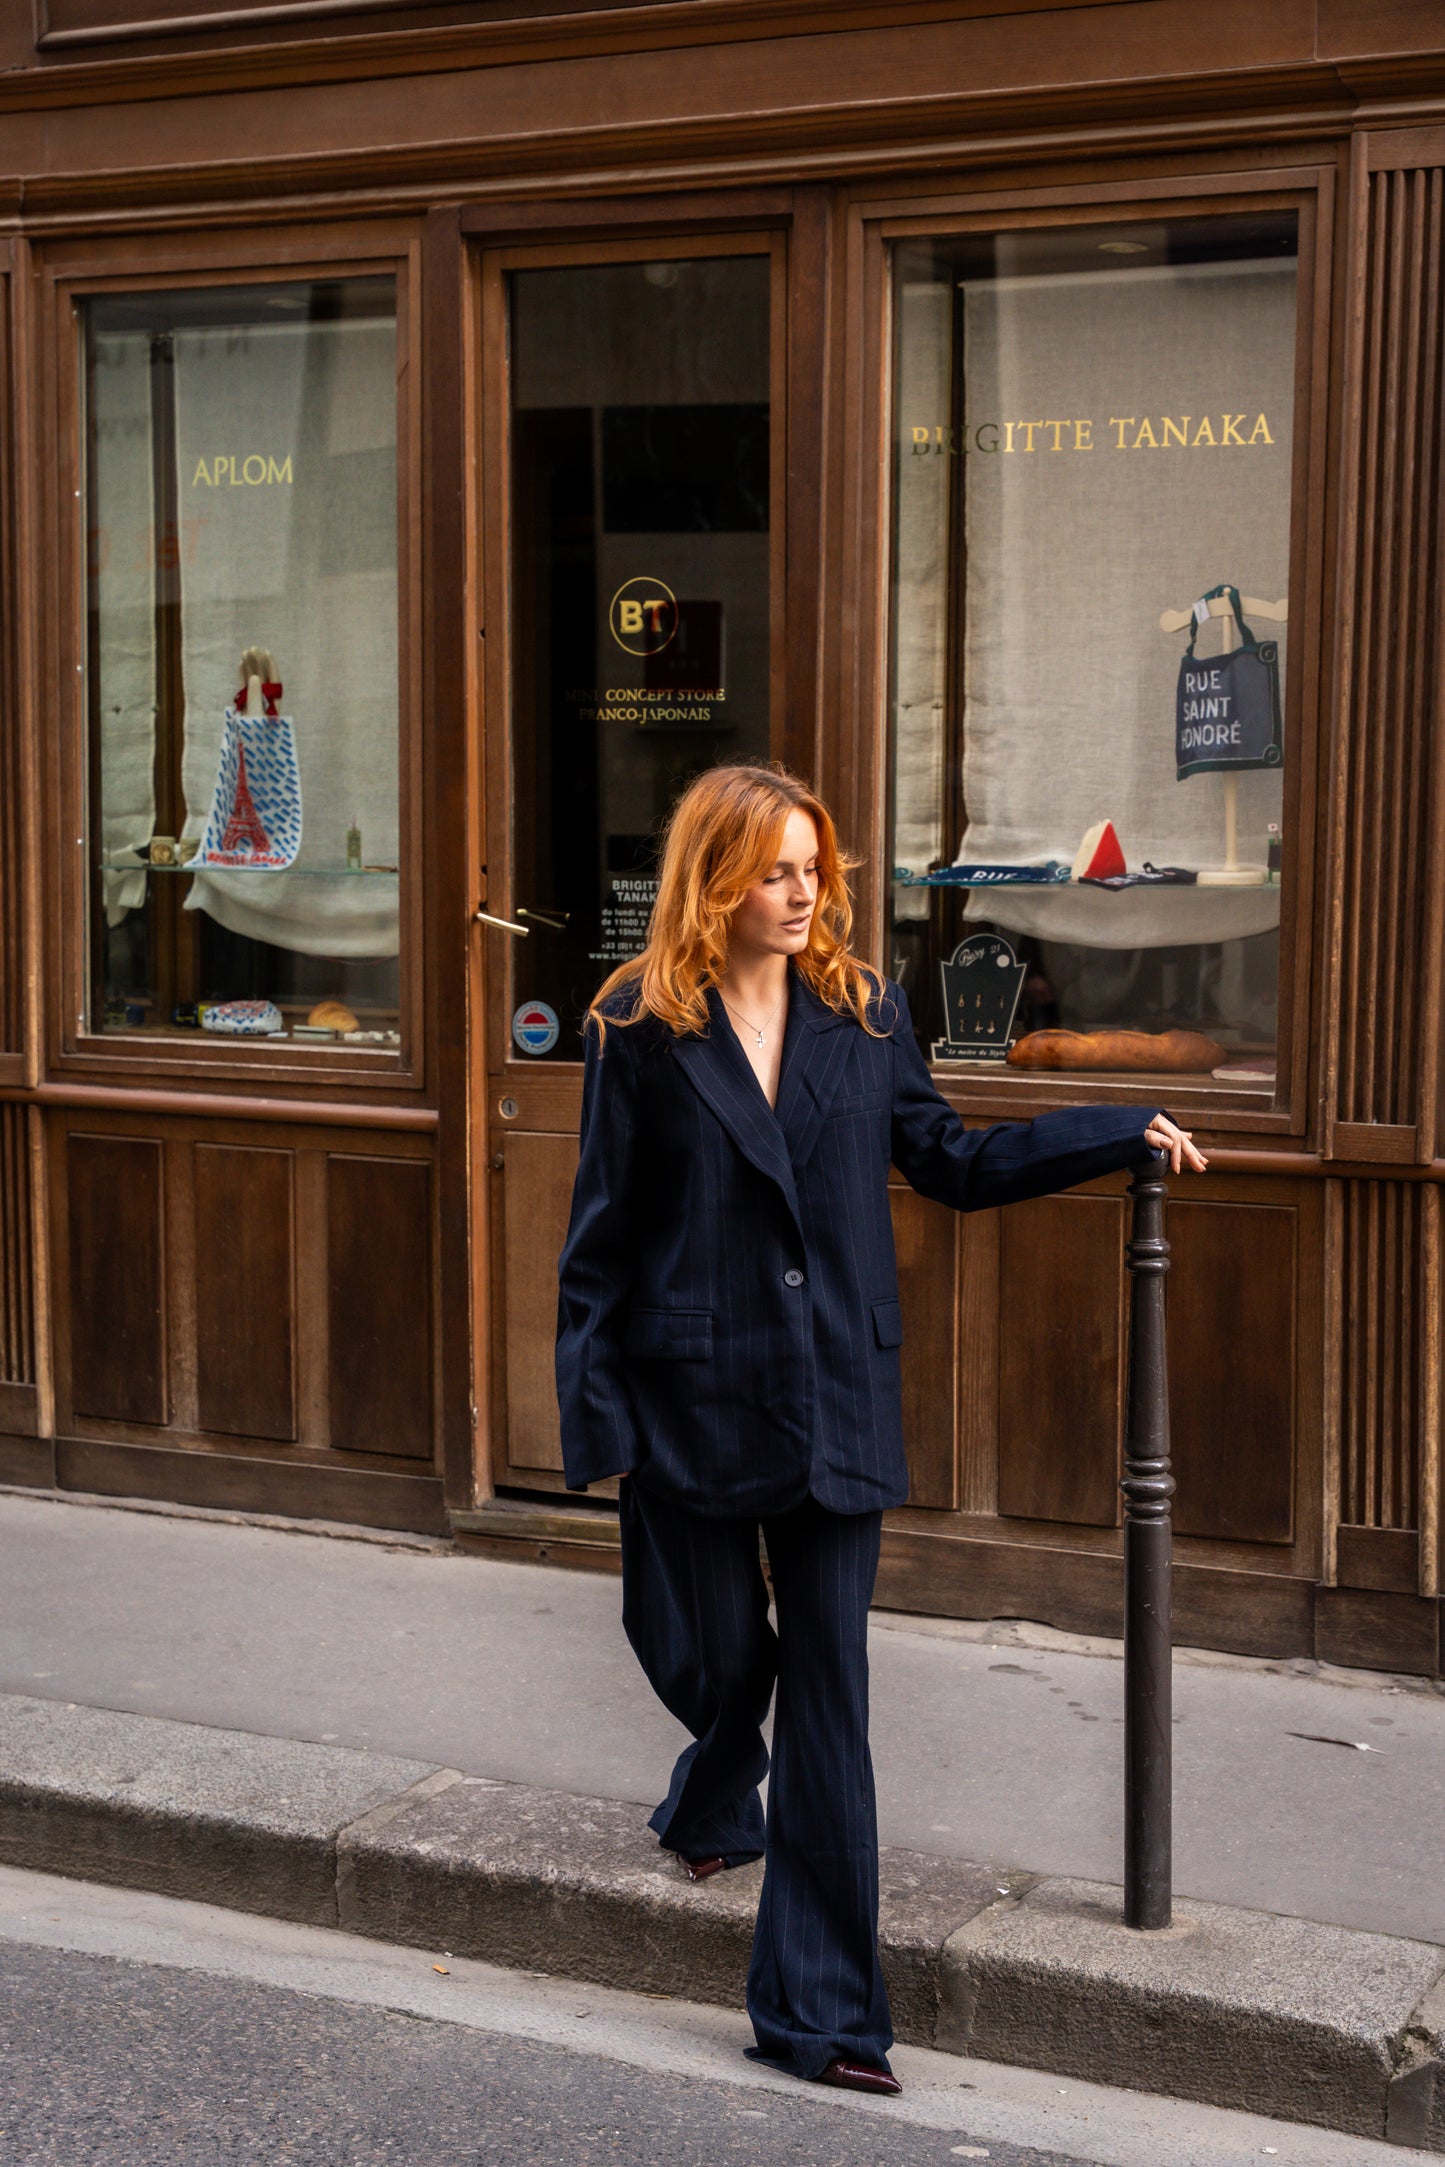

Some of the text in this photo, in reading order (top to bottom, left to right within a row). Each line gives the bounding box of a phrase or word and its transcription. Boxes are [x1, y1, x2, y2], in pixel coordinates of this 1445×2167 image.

[911, 413, 1275, 455] BRIGITTE TANAKA
[192, 455, 293, 487] APLOM
[619, 600, 669, 634] BT
[1185, 669, 1221, 694] RUE
[605, 688, 674, 701] CONCEPT
[677, 688, 726, 701] STORE
[579, 707, 711, 724] FRANCO-JAPONAIS
[1183, 697, 1231, 722] SAINT
[1181, 720, 1241, 750] HONORÉ
[612, 880, 661, 891] BRIGITT
[616, 892, 656, 902] TANAK
